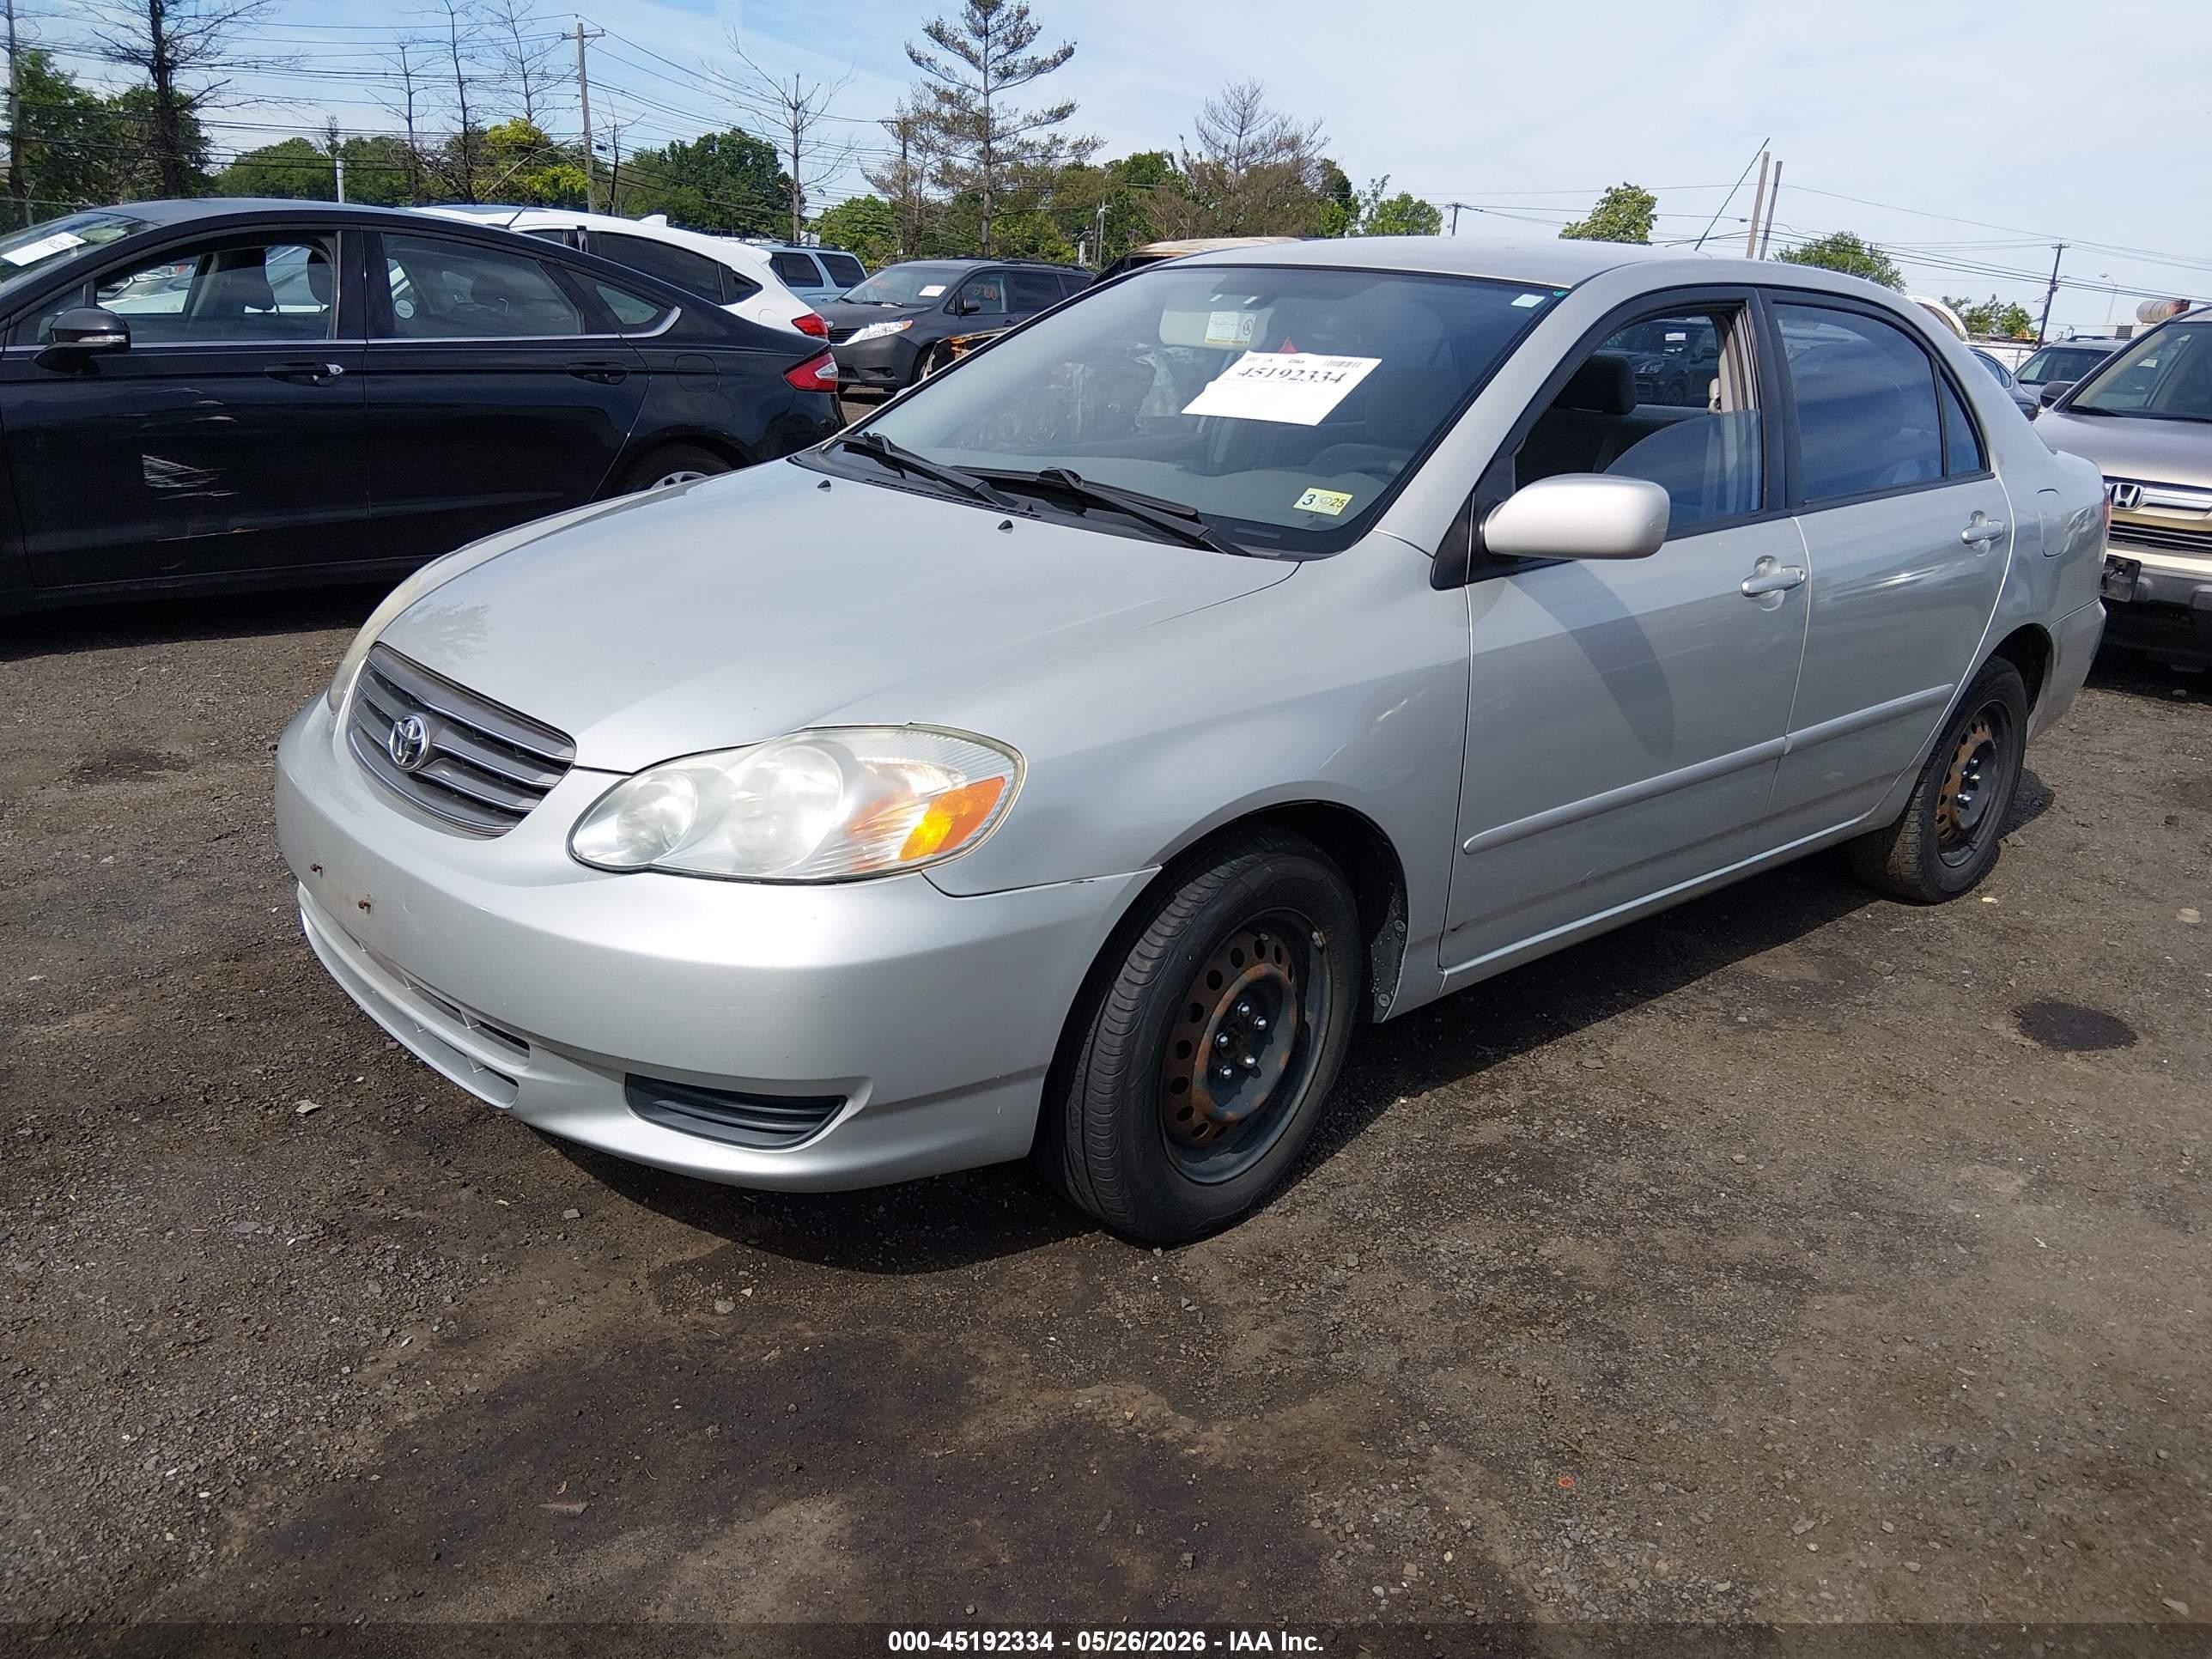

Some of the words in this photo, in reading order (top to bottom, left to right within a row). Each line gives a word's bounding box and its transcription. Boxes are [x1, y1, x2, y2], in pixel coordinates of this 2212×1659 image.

[1237, 367, 1347, 385] 45192334
[1302, 494, 1316, 506] 3
[1329, 498, 1346, 508] 25
